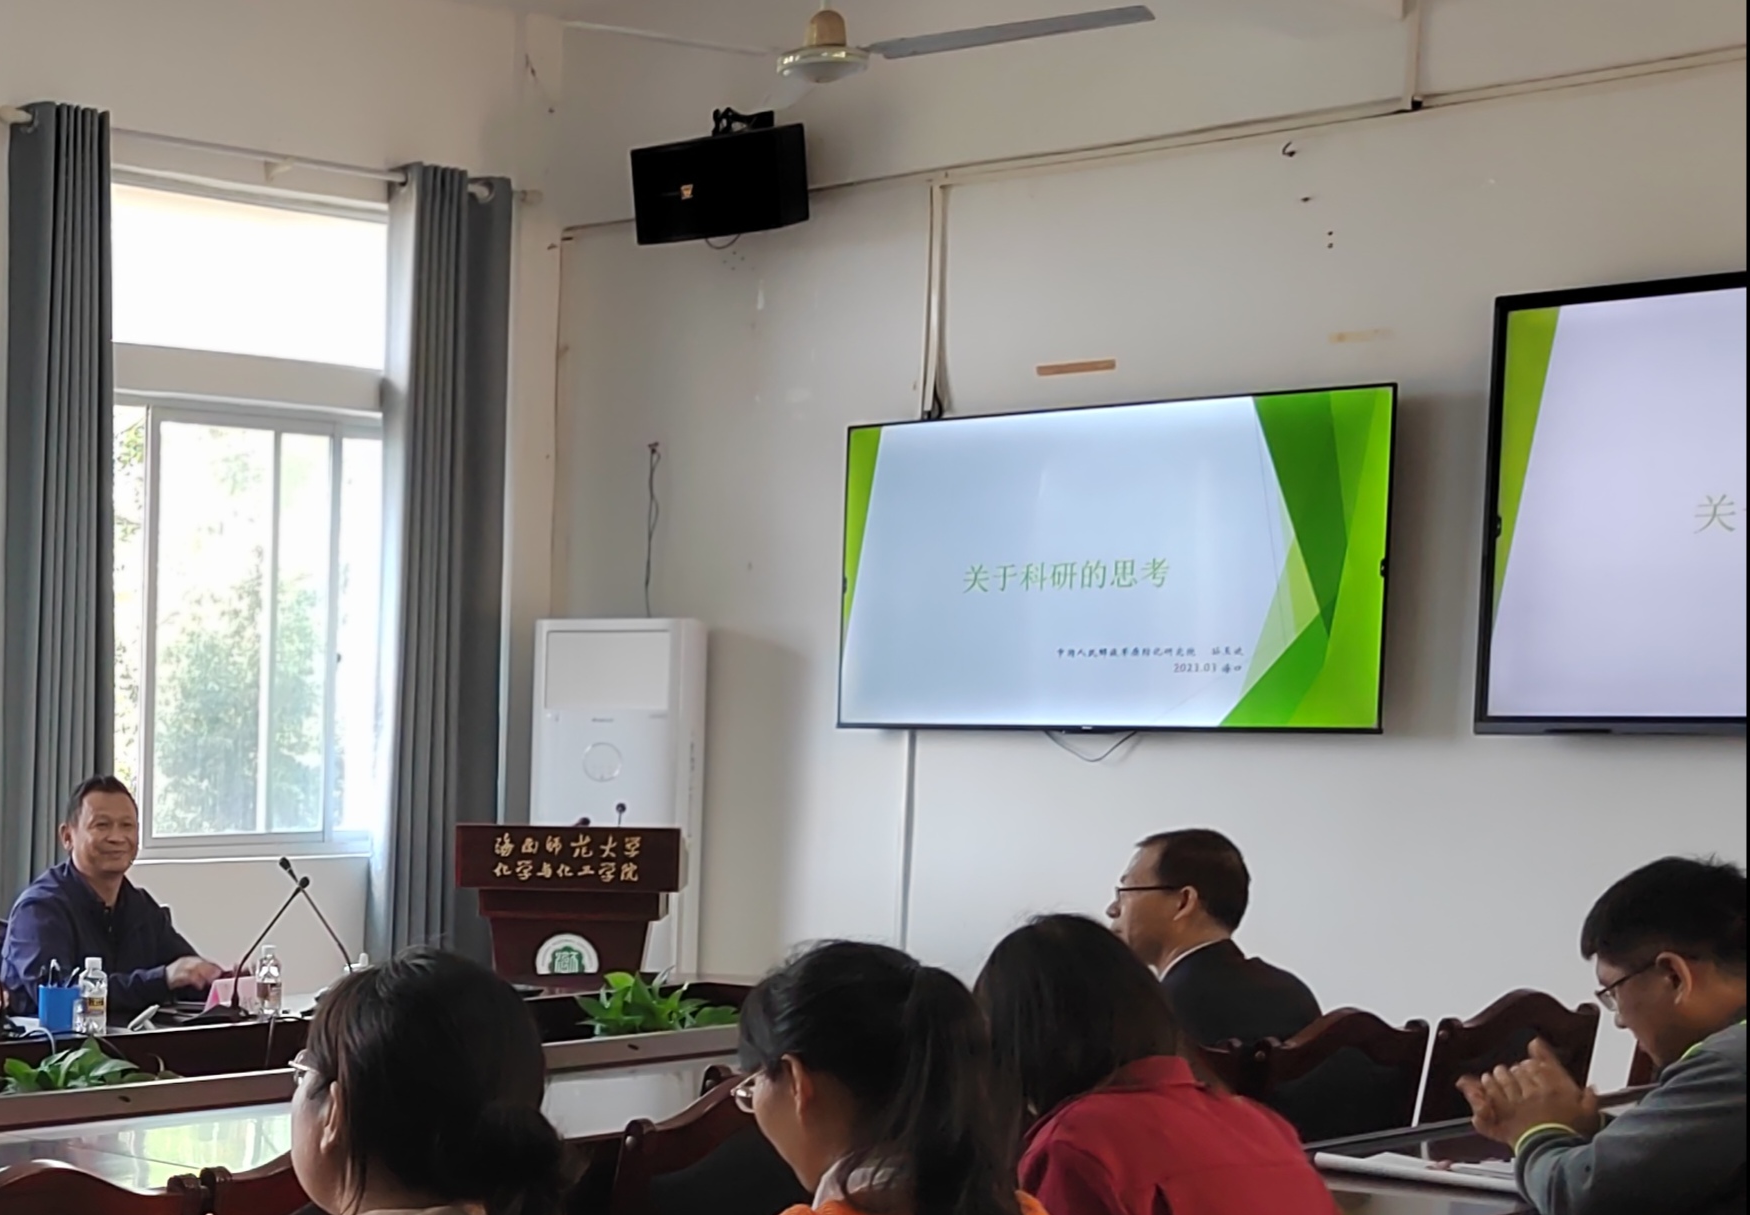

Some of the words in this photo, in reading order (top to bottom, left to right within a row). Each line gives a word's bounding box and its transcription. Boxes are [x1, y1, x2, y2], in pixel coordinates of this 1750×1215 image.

[1693, 493, 1745, 535] 关
[962, 557, 1170, 594] 关于科研的思考
[494, 832, 642, 858] 海南师范大学
[492, 860, 639, 883] 化学与化工学院
